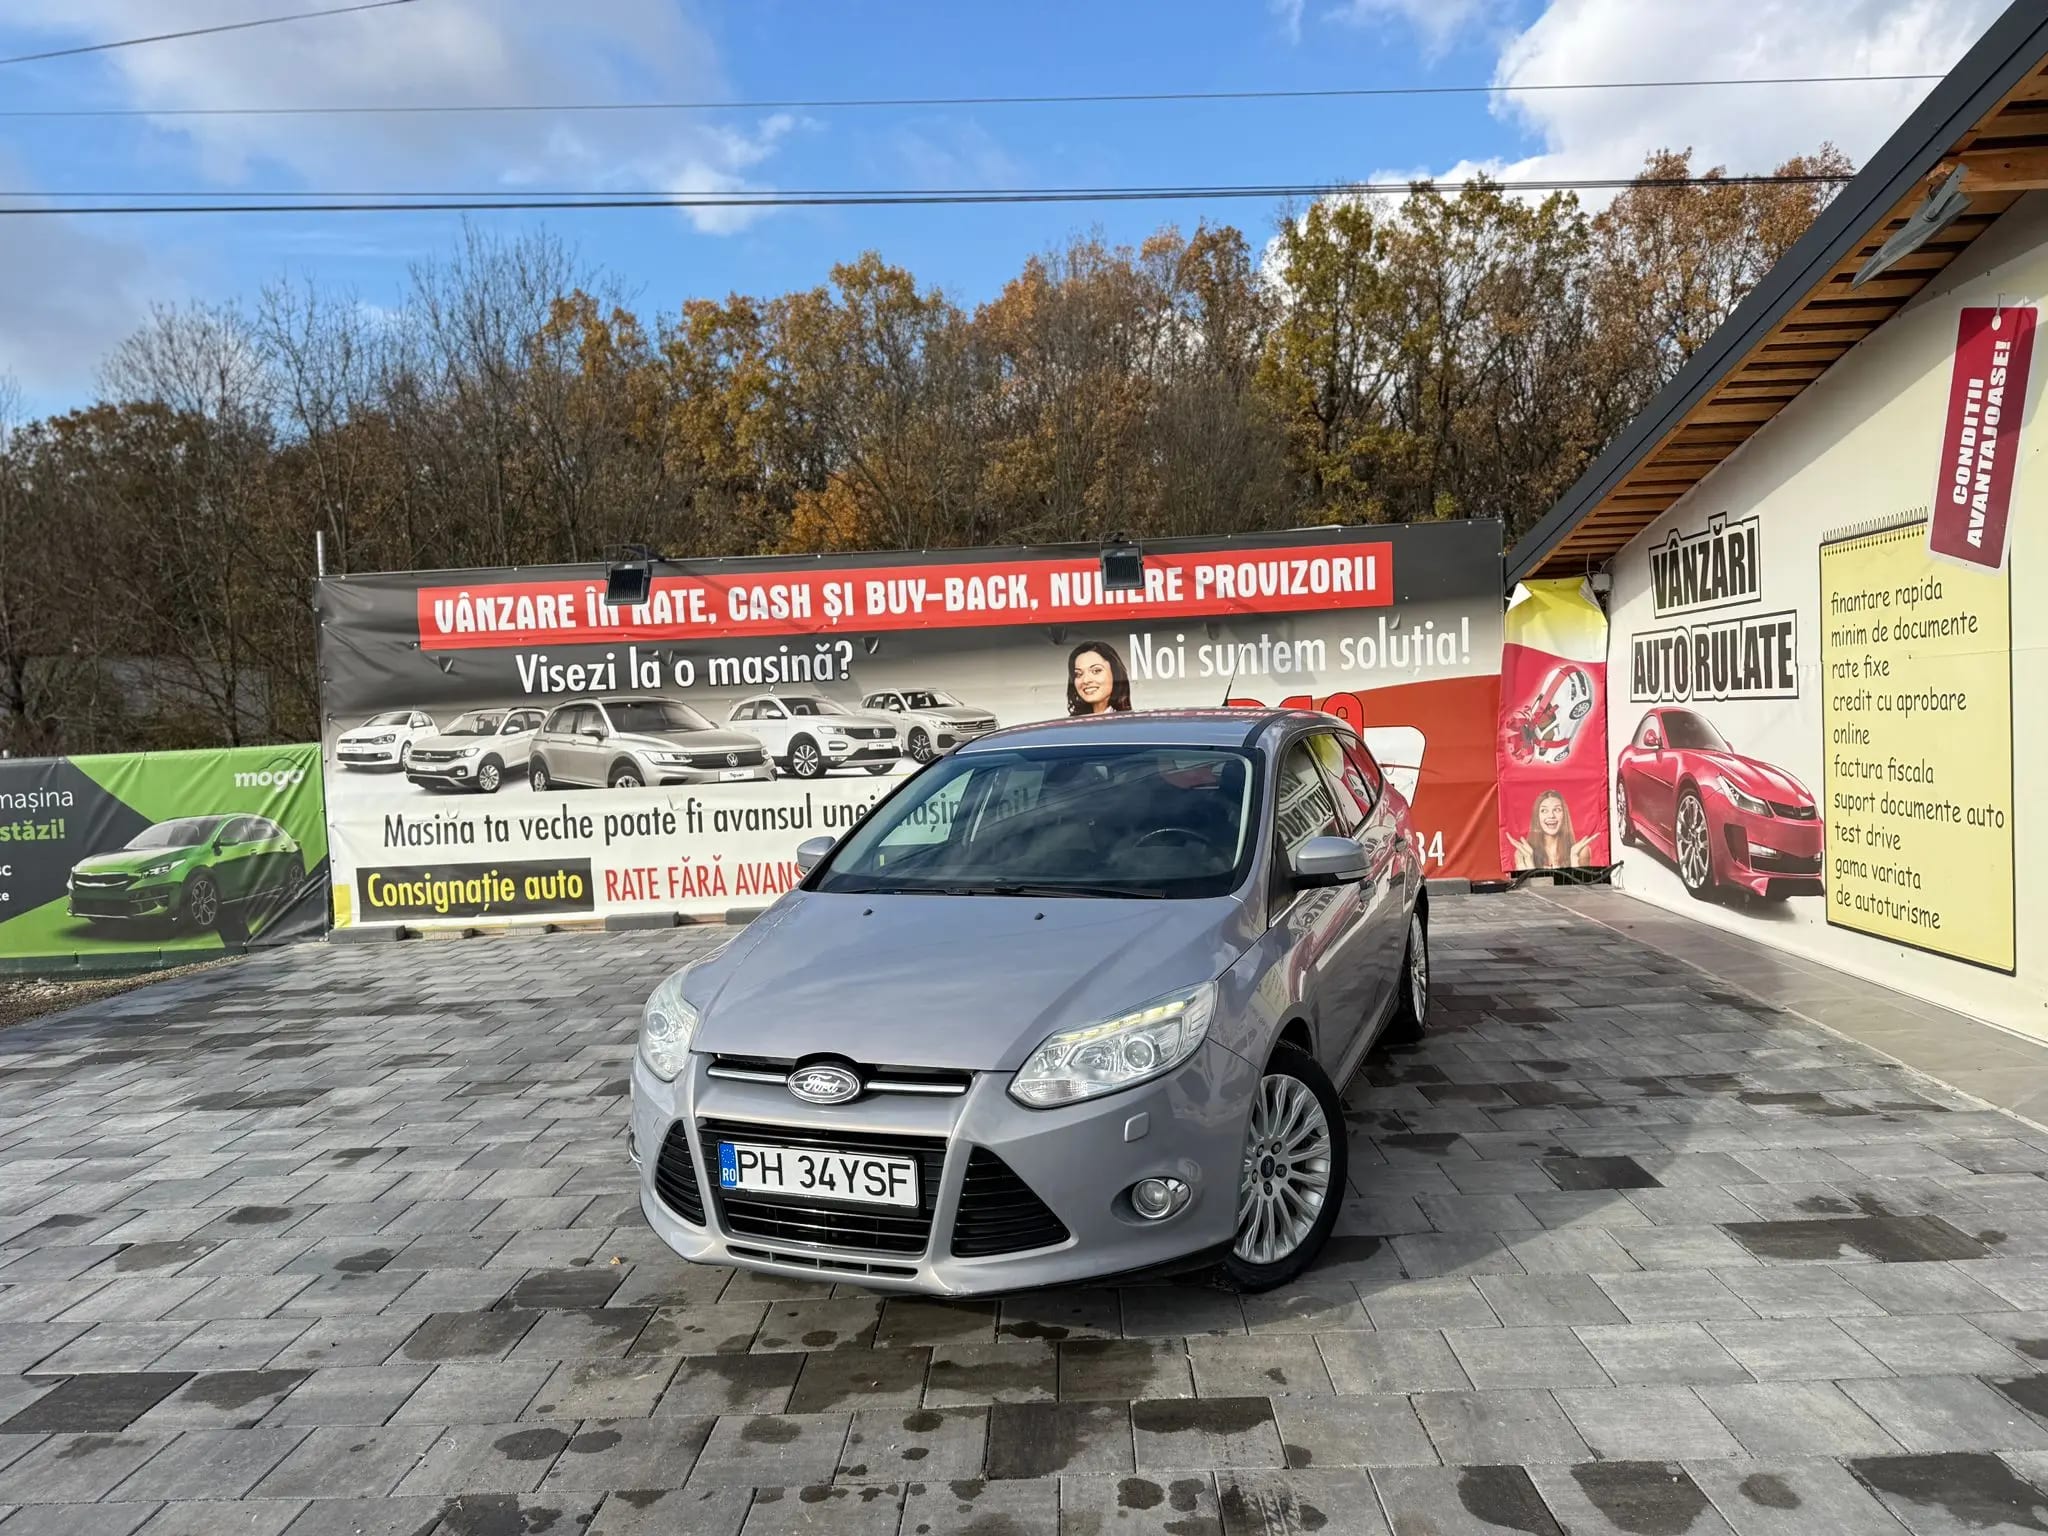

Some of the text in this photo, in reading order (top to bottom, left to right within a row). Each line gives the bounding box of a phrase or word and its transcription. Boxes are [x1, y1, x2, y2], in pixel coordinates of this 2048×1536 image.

[1953, 378, 1984, 505] CONDITII
[1967, 340, 2011, 549] AVANTAJOASE!
[1652, 523, 1757, 610] VÂNZĂRI
[434, 591, 577, 633] VÂNZARE
[728, 583, 811, 621] CASH
[822, 582, 854, 625] ȘI
[865, 574, 1039, 615] BUY-BACK,
[1195, 555, 1376, 600] PROVIZORII
[1831, 575, 1943, 616] finantare rapida
[1129, 616, 1470, 681] Noi suntem soluția!
[1831, 611, 1978, 648] minim de documente
[515, 652, 617, 694] Visezi
[629, 646, 661, 689] la
[675, 658, 695, 687] o
[1633, 621, 1794, 695] AUTO RULATE
[1832, 654, 1890, 679] rate fixe
[1833, 686, 1967, 718] credit cu aprobare
[1833, 721, 1871, 745] online
[234, 769, 306, 793] mogo
[1834, 754, 1934, 784] factura fiscala
[484, 815, 509, 842] ta
[519, 803, 593, 840] veche
[604, 807, 676, 846] poate
[687, 797, 703, 833] fi
[714, 793, 812, 831] avansul
[1834, 791, 2005, 829] suport documente auto
[1835, 821, 1901, 850] test drive
[368, 869, 583, 913] Consignație auto
[605, 867, 660, 902] RATE
[668, 854, 728, 898] FĂRĂ
[1835, 857, 1921, 890] gama variata
[1836, 884, 1941, 929] de autoturisme
[803, 1073, 841, 1095] Ford
[723, 1168, 736, 1182] RO
[737, 1150, 911, 1198] PH 34YSF
